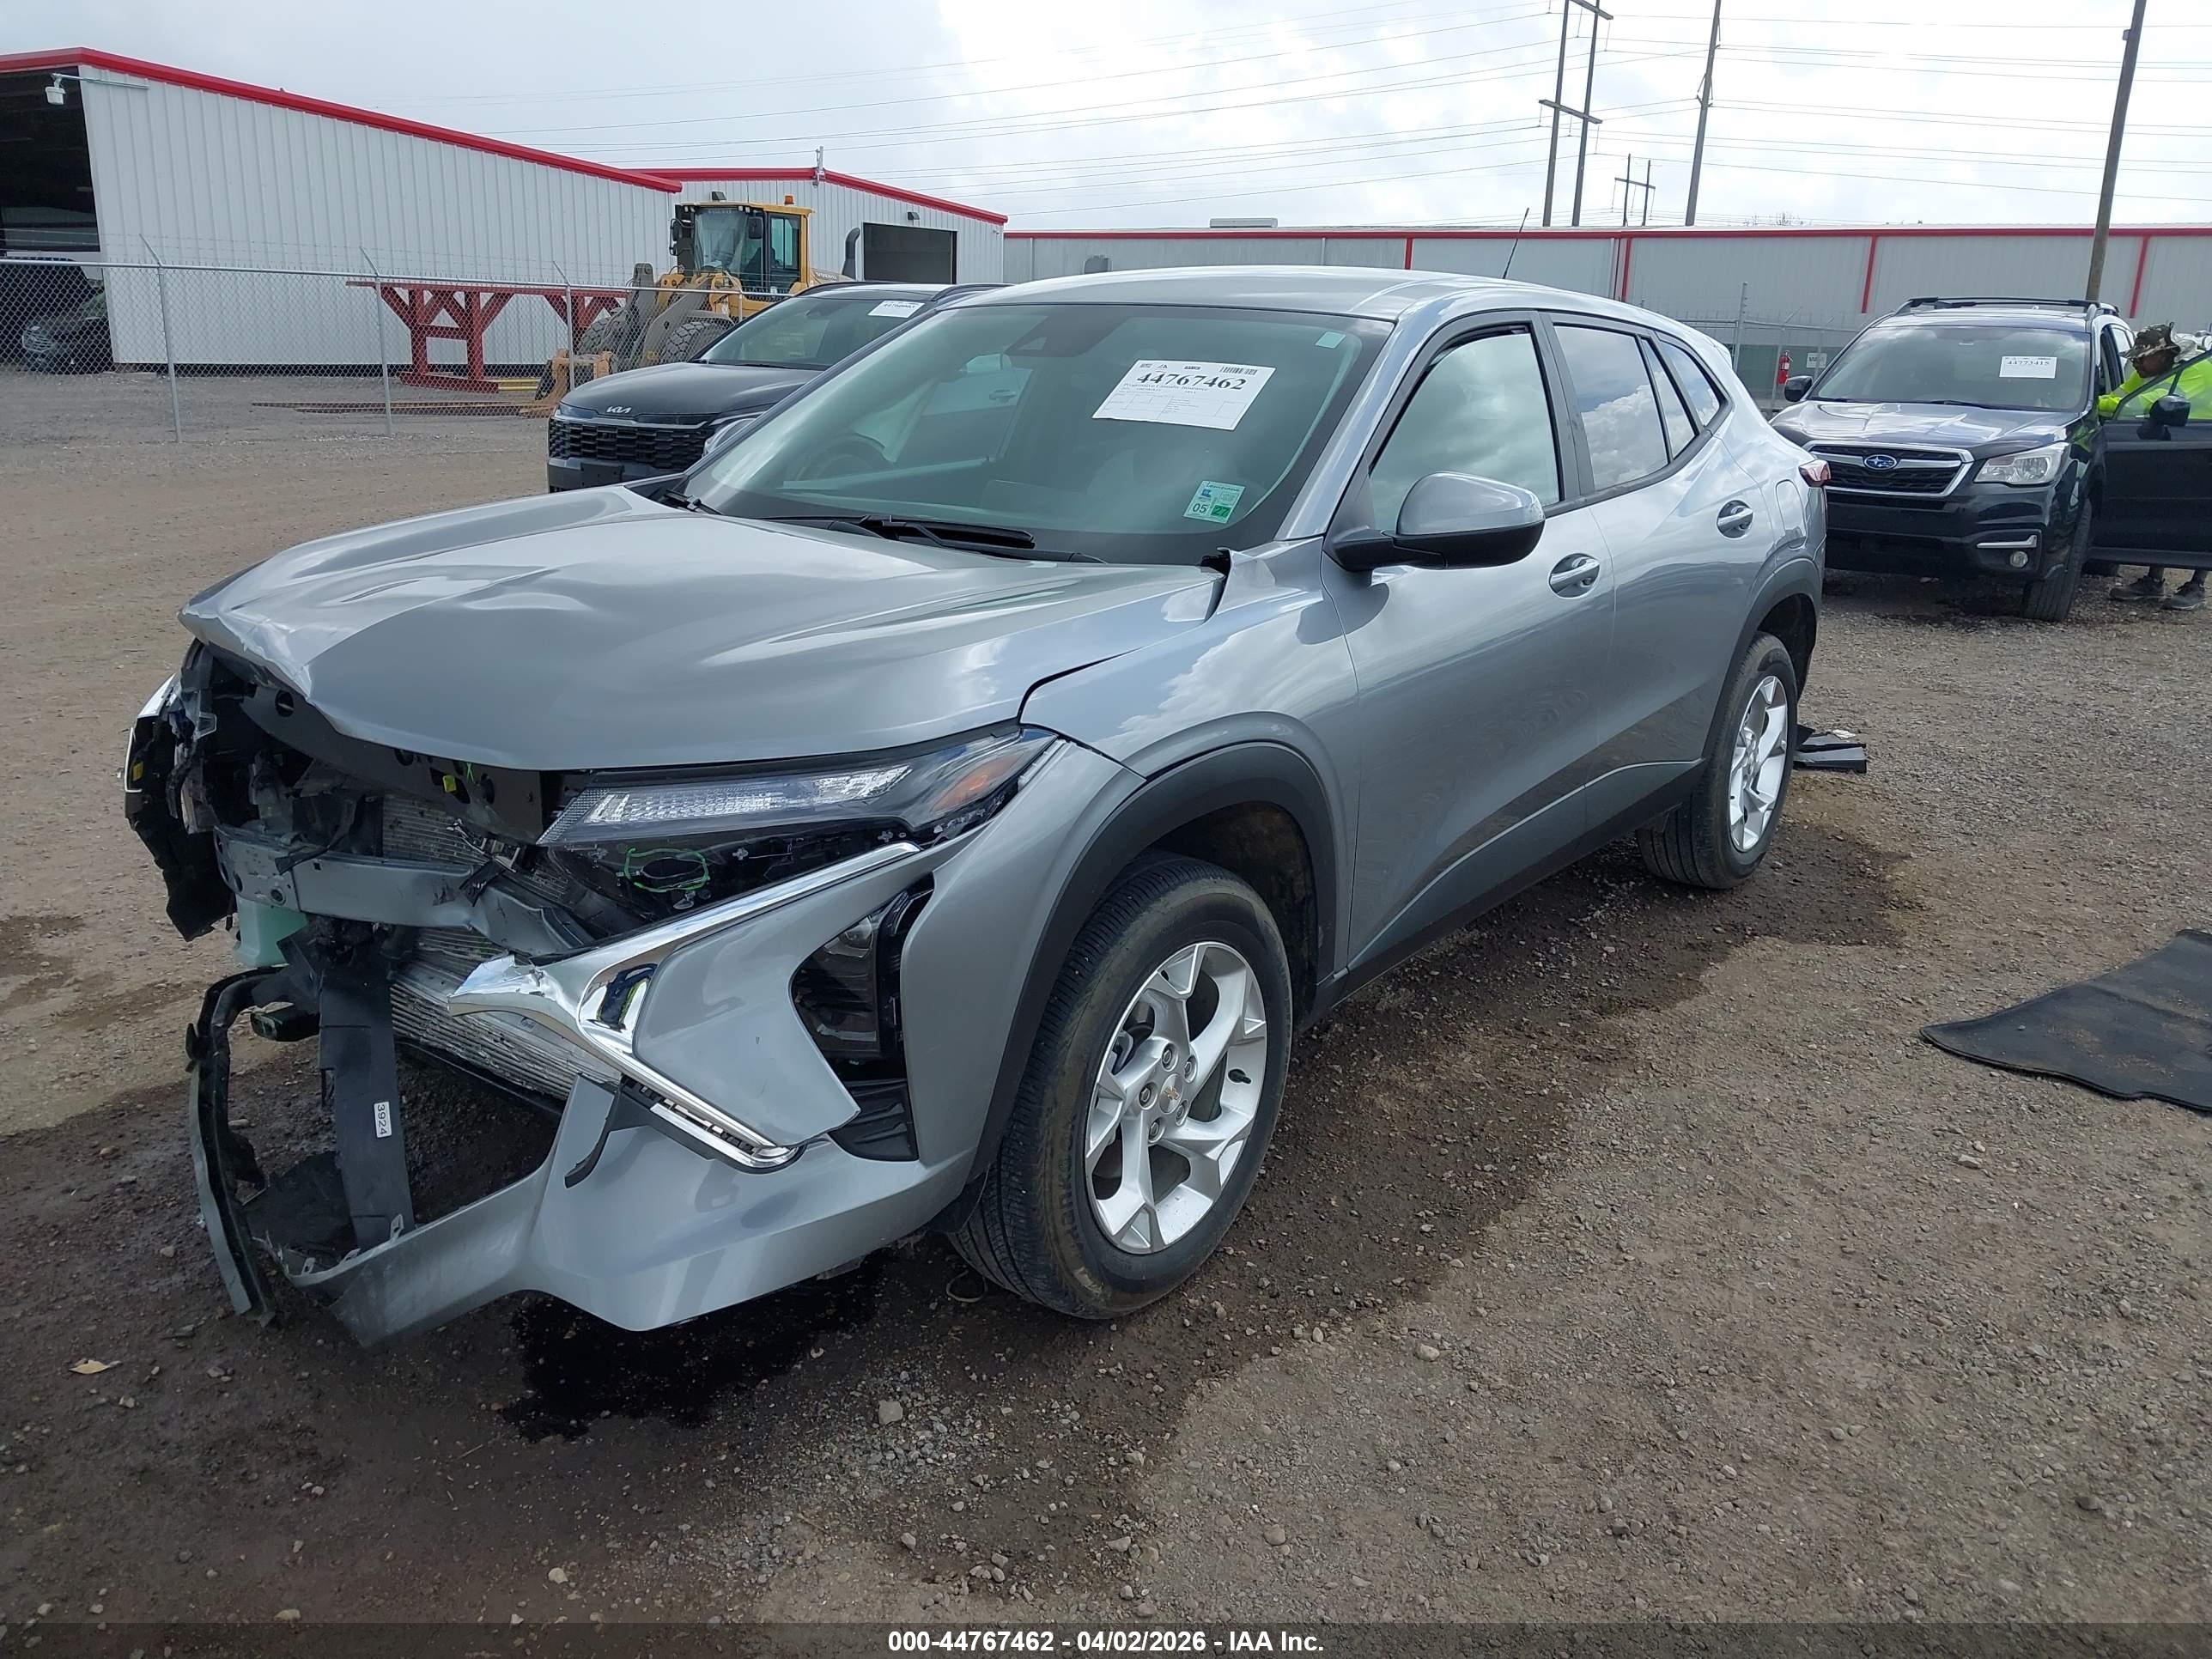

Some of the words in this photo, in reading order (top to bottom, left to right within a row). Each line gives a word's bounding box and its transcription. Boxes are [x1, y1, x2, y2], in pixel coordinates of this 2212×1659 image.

[1136, 372, 1247, 391] 44767462
[1192, 502, 1207, 514] 05
[1215, 506, 1230, 518] 27
[377, 1103, 387, 1135] 3924
